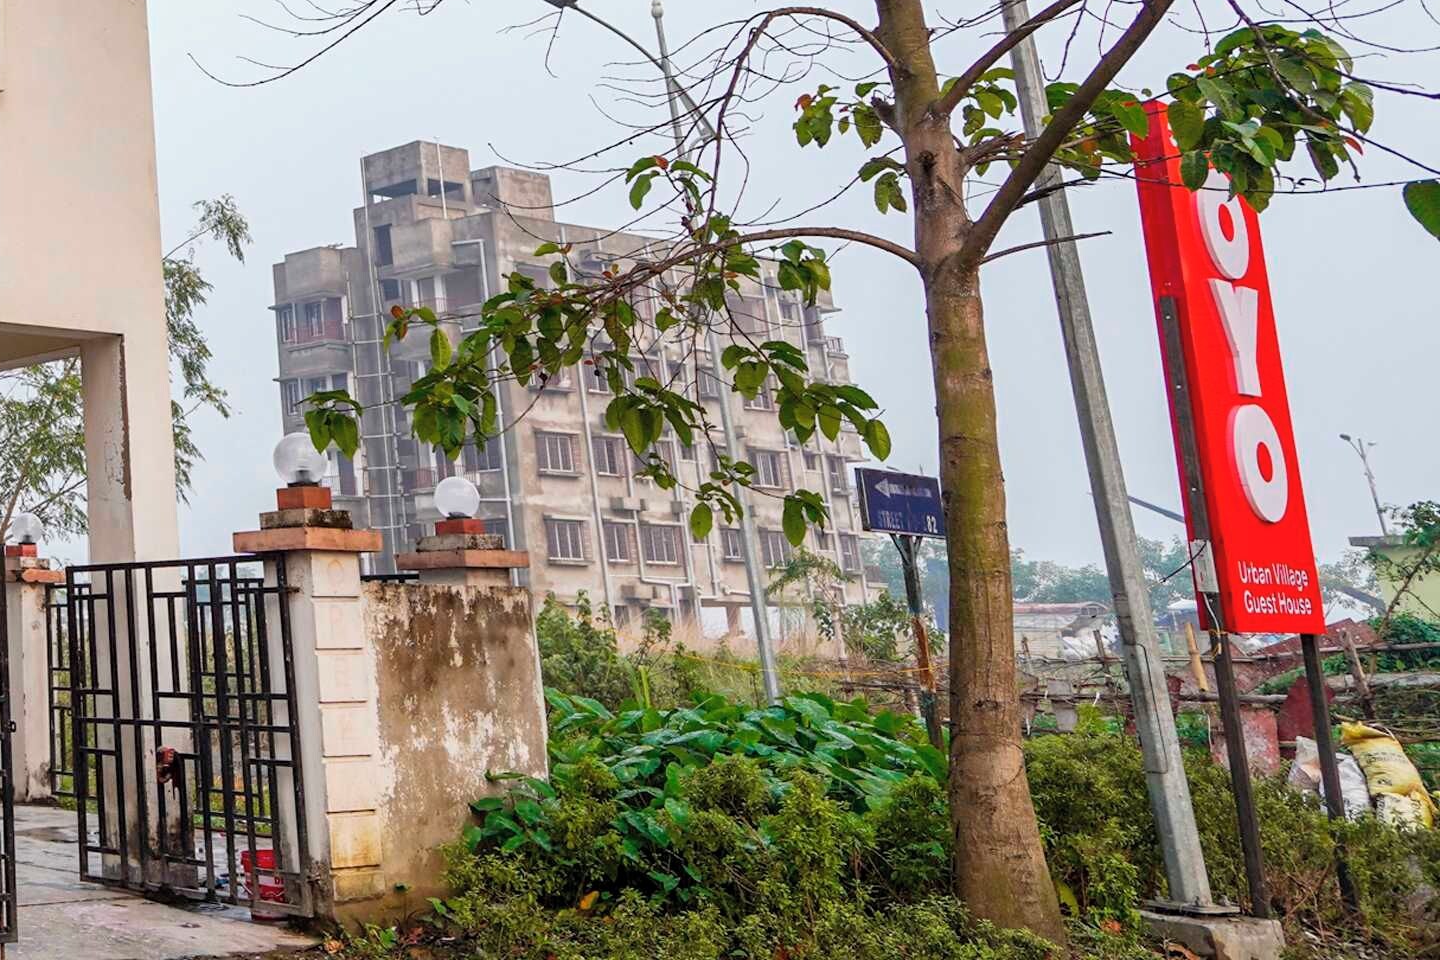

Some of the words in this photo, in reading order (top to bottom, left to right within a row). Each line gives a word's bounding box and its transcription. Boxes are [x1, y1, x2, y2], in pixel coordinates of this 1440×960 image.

[1192, 167, 1289, 525] OYO
[1238, 560, 1272, 585] Urban
[1271, 562, 1308, 592] Village
[1243, 589, 1278, 614] Guest
[1277, 592, 1312, 615] House
